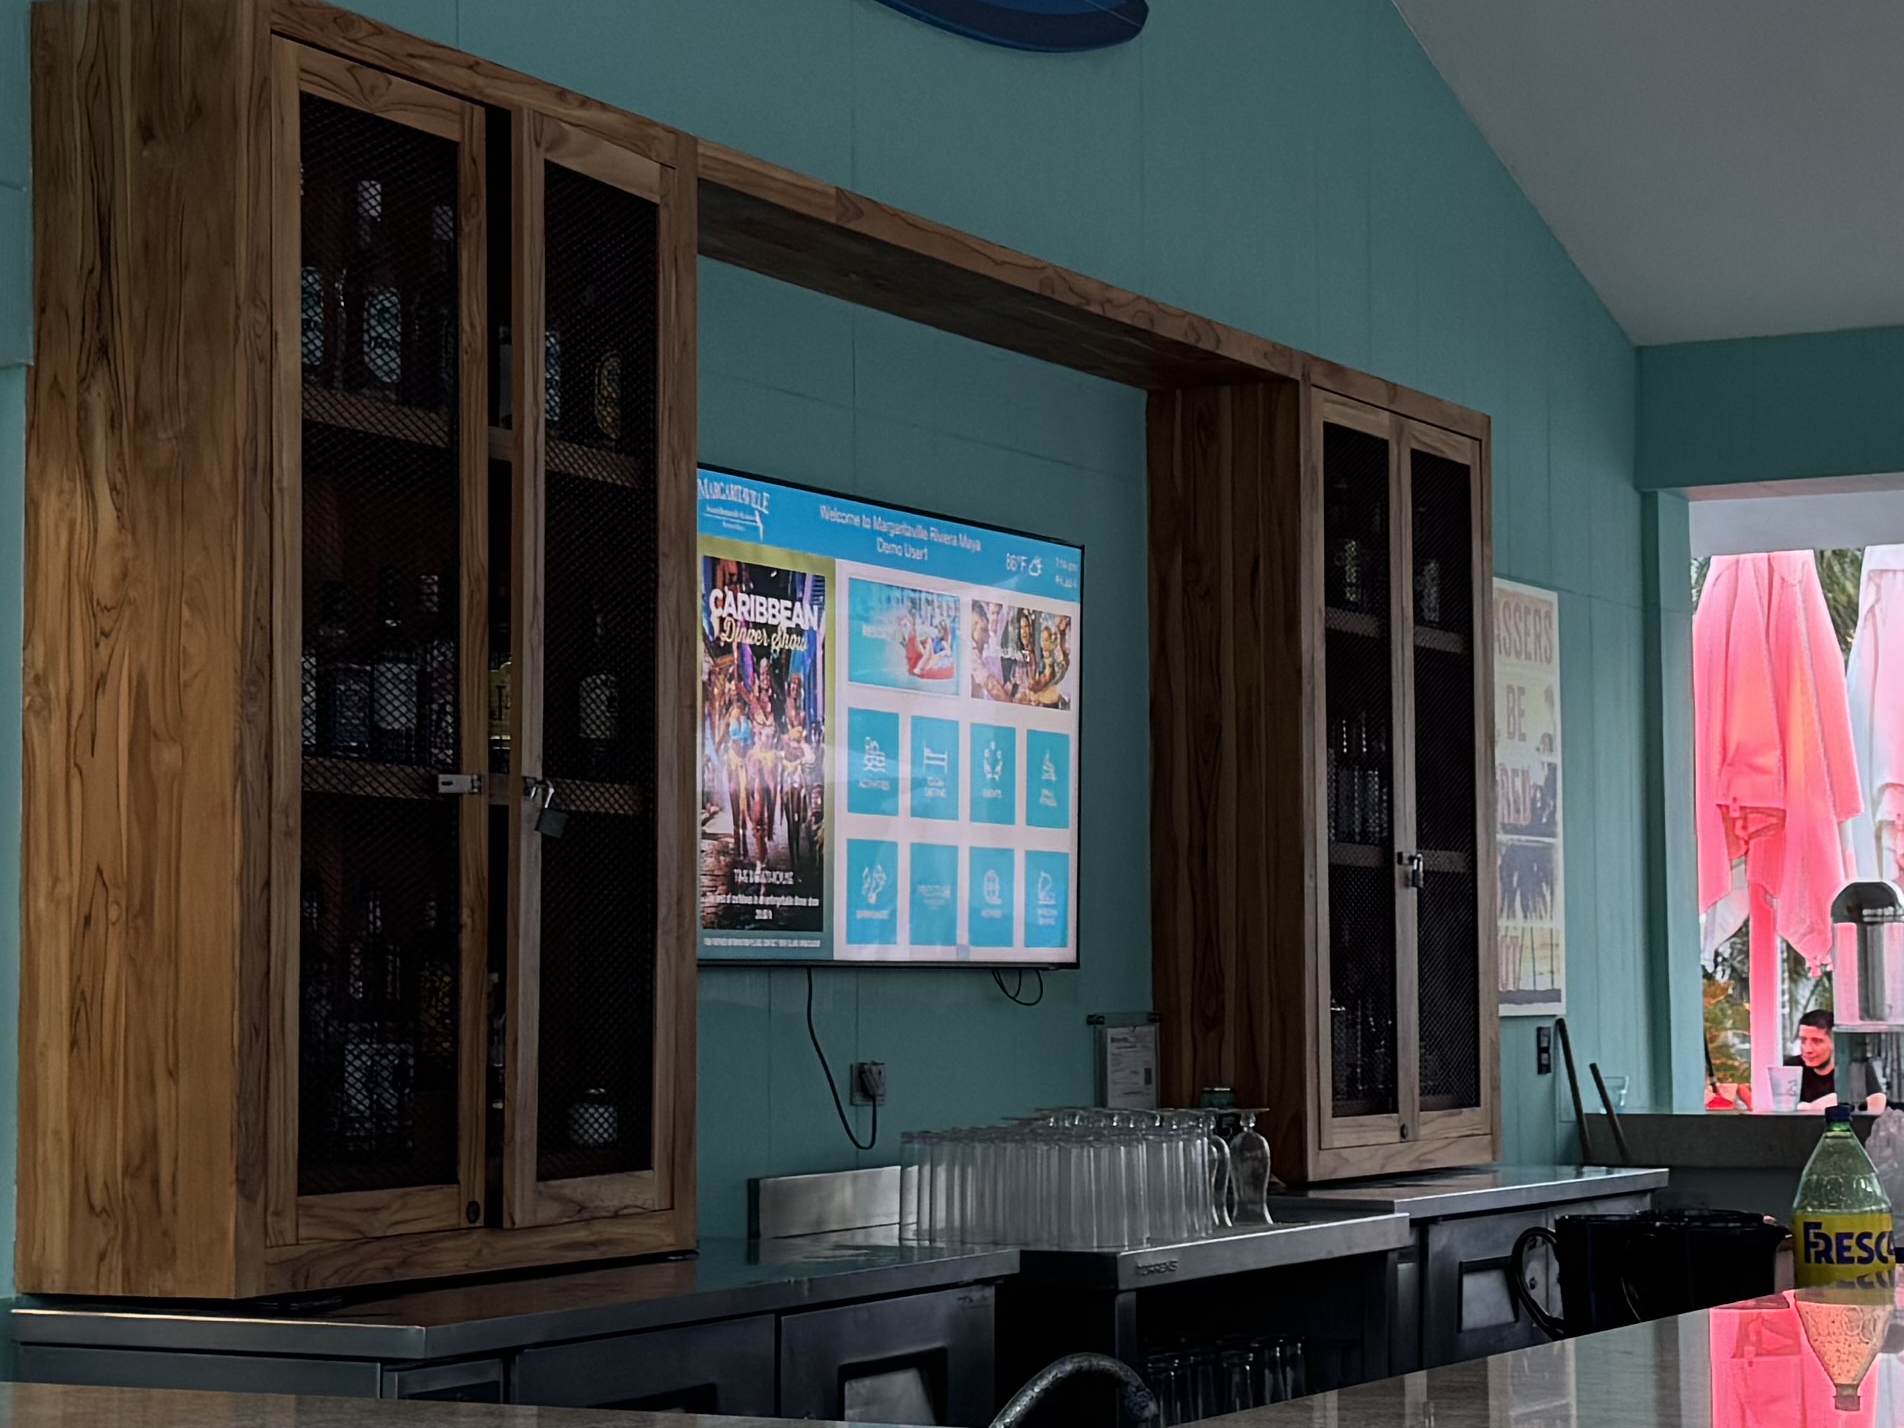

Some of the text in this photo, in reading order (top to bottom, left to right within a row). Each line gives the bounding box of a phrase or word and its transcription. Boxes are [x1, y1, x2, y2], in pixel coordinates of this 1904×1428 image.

[819, 504, 861, 528] Welcome
[877, 537, 903, 557] Demo
[708, 586, 818, 632] CARIBBEAN
[720, 616, 809, 657] Dinner Show
[1505, 683, 1527, 743] BE
